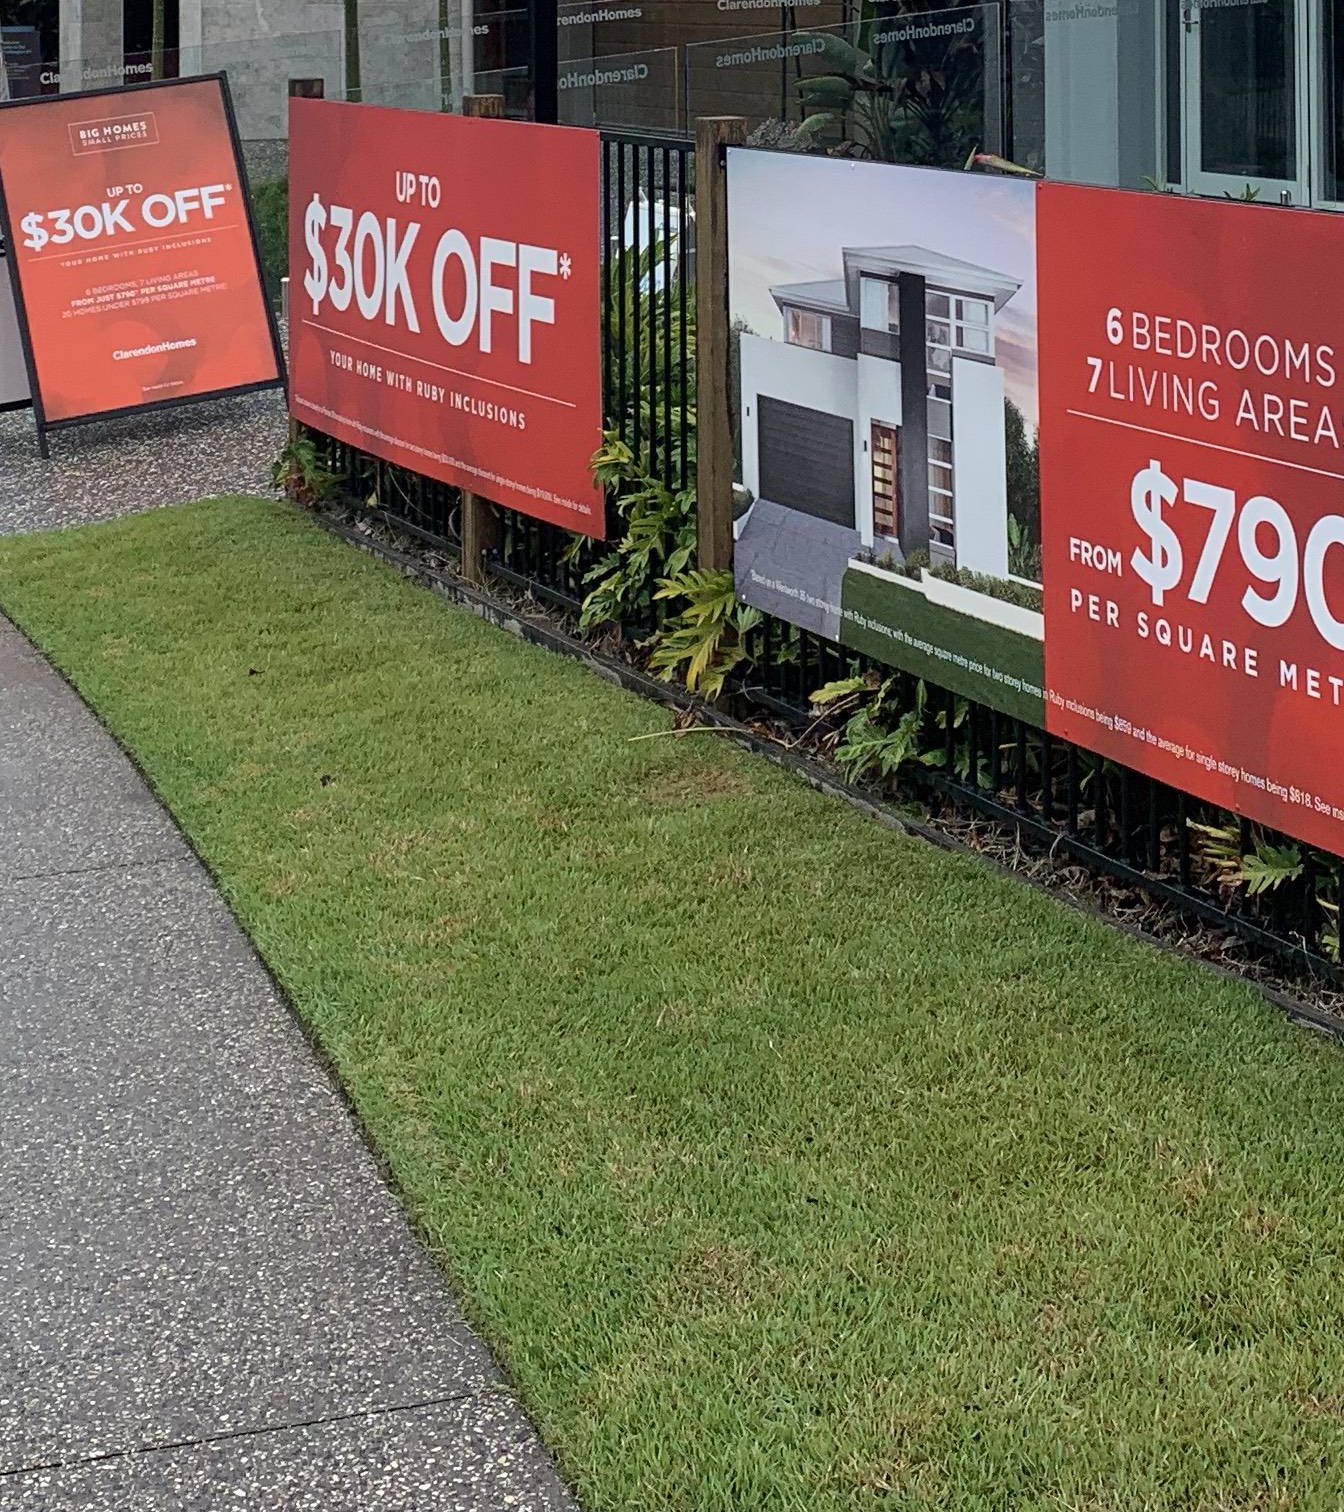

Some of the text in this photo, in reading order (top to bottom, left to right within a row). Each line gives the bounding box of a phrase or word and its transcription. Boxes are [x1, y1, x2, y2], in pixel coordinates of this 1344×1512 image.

[557, 8, 642, 26] rendonHomes
[79, 121, 147, 139] BIG HOMES
[82, 131, 148, 146] SMALL PRICES
[106, 183, 143, 198] UP TO
[396, 171, 441, 209] UP TO
[20, 198, 137, 252] $30K
[60, 237, 212, 268] YOUR HOME WITH RUBY INCLUSIONS
[304, 193, 421, 334] $30K
[71, 297, 95, 308] FROM
[96, 293, 114, 304] JUST
[140, 286, 156, 295] PER
[157, 281, 189, 293] SQUARE
[190, 275, 216, 287] METRE
[145, 274, 171, 285] LIVING
[173, 270, 199, 280] AREAS
[73, 306, 102, 317] HOMES
[102, 301, 130, 312] UNDER
[151, 294, 167, 303] PER
[168, 288, 199, 300] SQUARE
[112, 338, 197, 361] ClarendonHomes
[1106, 307, 1337, 387] 6 BEDROOMS
[329, 349, 526, 430] YOUR HOME WITH RUBY INCLUSIONS
[1086, 356, 1103, 393] 7
[1109, 360, 1221, 422] LIVING
[1069, 536, 1122, 578] FROM
[1071, 588, 1120, 629] PER
[1137, 611, 1259, 677] SQUARE
[843, 609, 853, 621] with
[854, 610, 866, 629] Ruby
[893, 629, 903, 642] with
[904, 631, 912, 646] the
[913, 638, 934, 655] average
[934, 646, 952, 662] square
[952, 653, 968, 668] metre
[968, 659, 983, 674] price
[983, 663, 991, 678] for
[992, 668, 1003, 683] two
[1004, 673, 1021, 692] storey
[1021, 678, 1042, 698] homes
[1042, 686, 1048, 701] in
[1049, 689, 1065, 710] Ruby
[1065, 699, 1095, 720] inclusions
[1095, 707, 1113, 730] being
[1133, 727, 1145, 740] and
[1146, 729, 1157, 746] the
[1157, 737, 1184, 759] average
[1185, 744, 1196, 761] for
[1196, 750, 1217, 772] single
[1218, 761, 1240, 782] storey
[1240, 767, 1265, 790] homes
[1266, 777, 1288, 803] being
[1314, 796, 1331, 816] See
